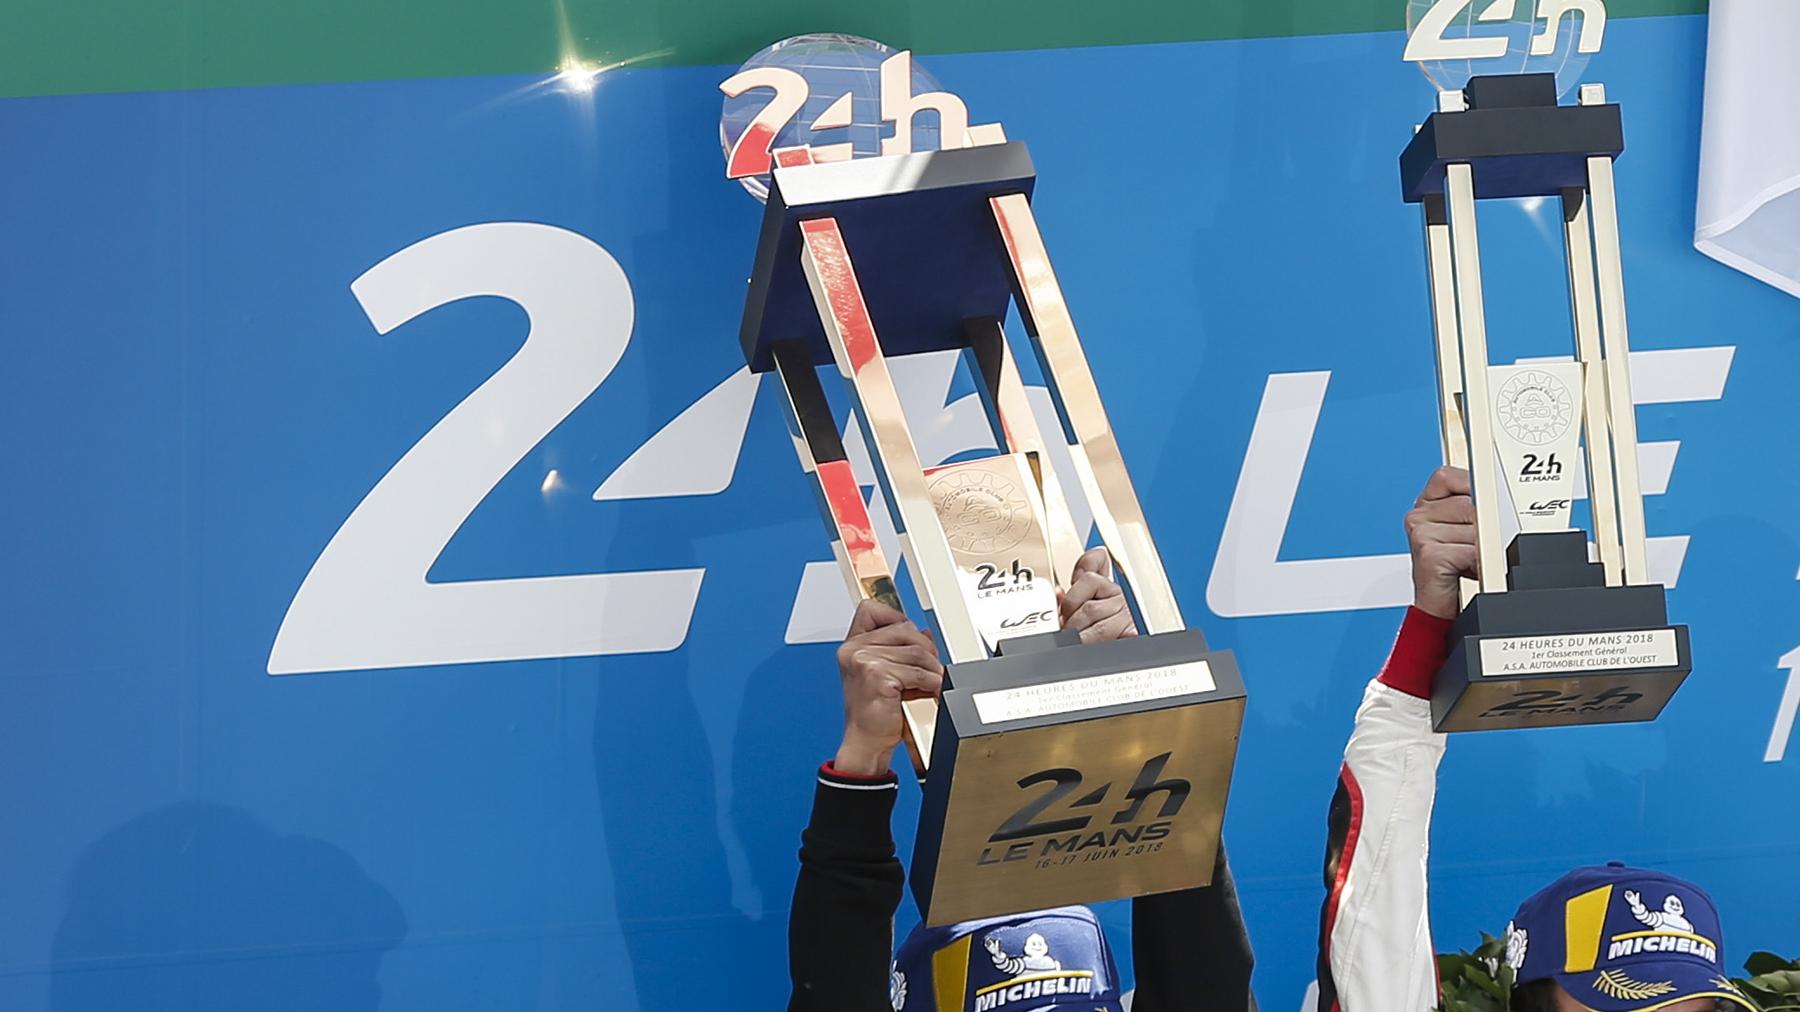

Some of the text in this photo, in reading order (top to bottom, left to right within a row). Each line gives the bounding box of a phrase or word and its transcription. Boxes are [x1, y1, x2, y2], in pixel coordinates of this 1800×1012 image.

[1520, 453, 1562, 475] 24h
[1529, 499, 1570, 510] WEC
[975, 558, 1032, 590] 24h
[977, 584, 1034, 599] LE MANS
[1000, 610, 1053, 629] WEC
[1502, 633, 1654, 651] 24 HEURES DU MANS 2018
[1529, 659, 1585, 670] AUTOMOBILE
[1586, 657, 1608, 667] CLUB
[1609, 656, 1621, 665] DE
[1488, 686, 1643, 711] 24h
[988, 751, 1191, 843] 24h
[976, 821, 1172, 866] LE MANS
[1084, 848, 1119, 863] JUIN
[1125, 841, 1164, 857] 2018
[1607, 935, 1717, 963] MICHELIN
